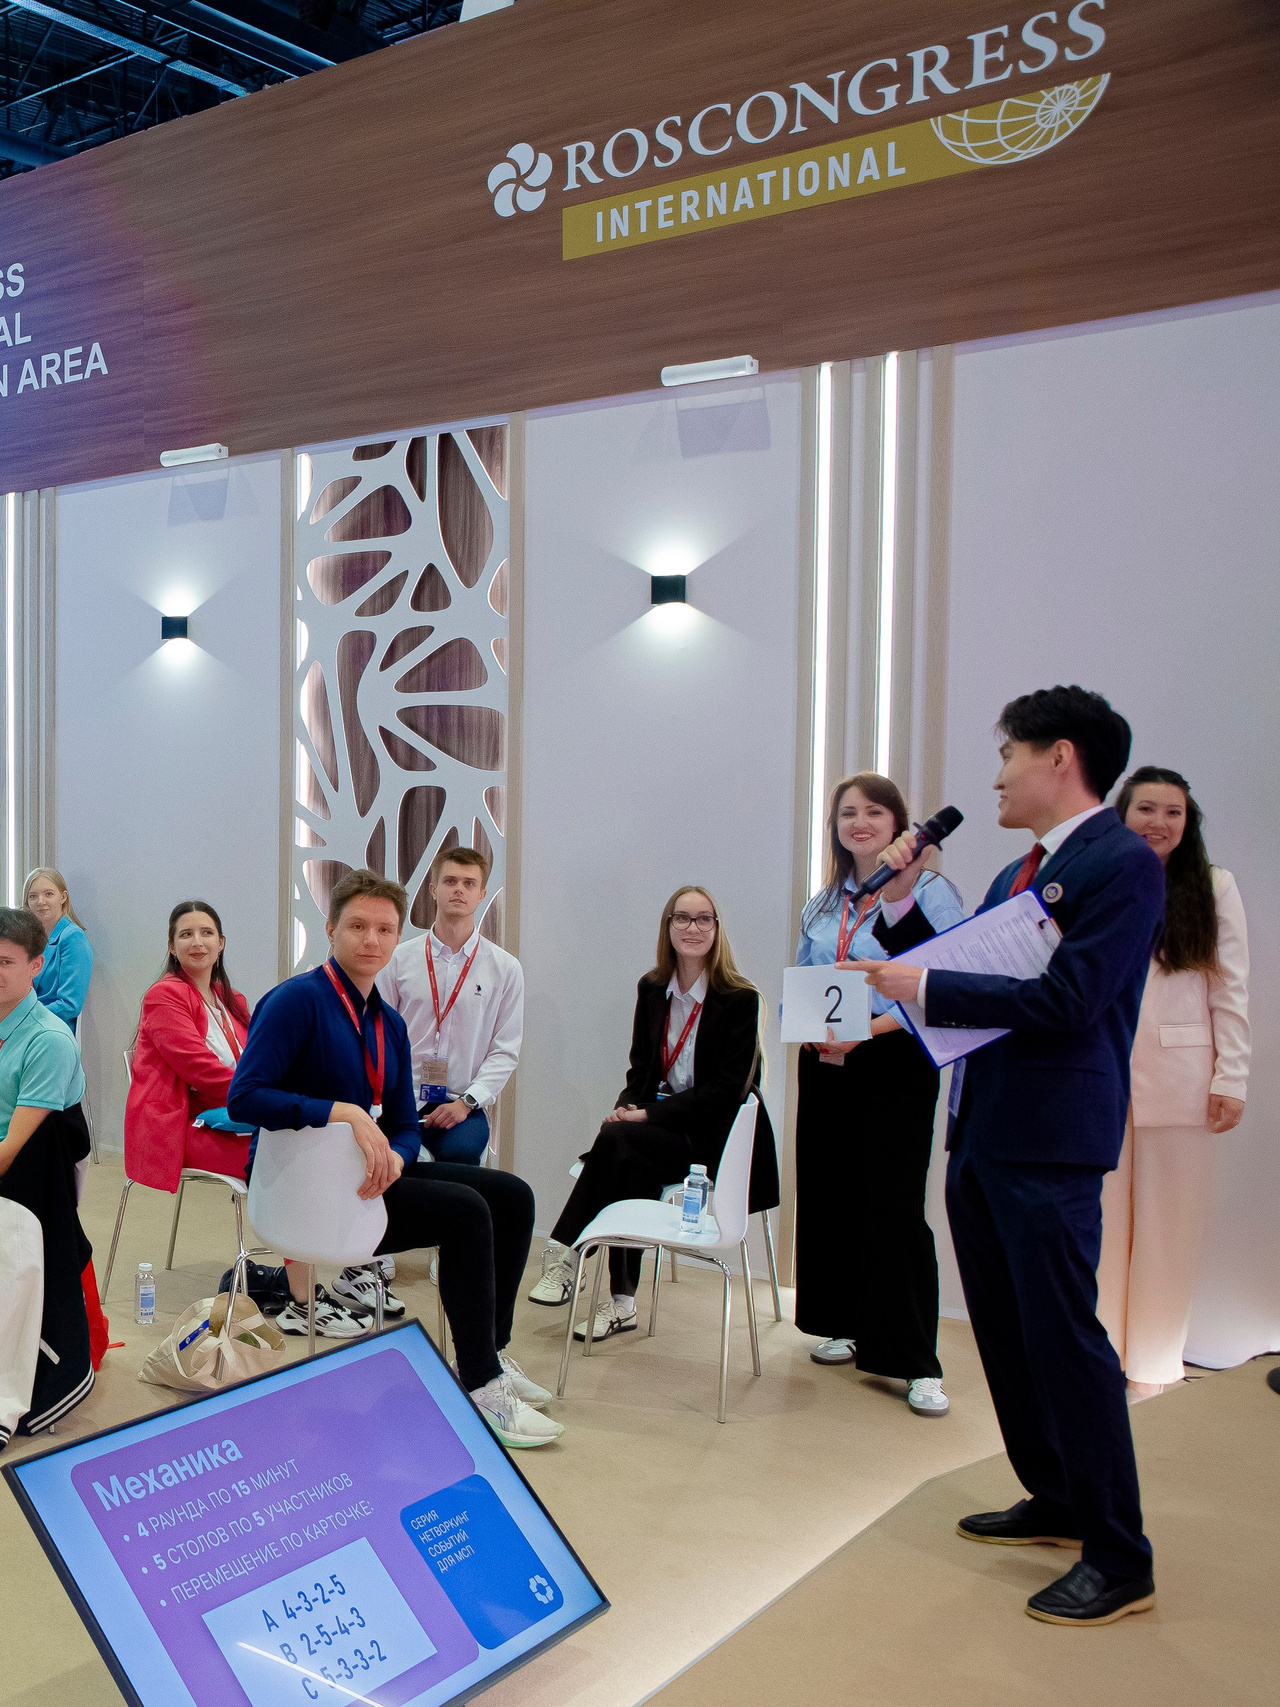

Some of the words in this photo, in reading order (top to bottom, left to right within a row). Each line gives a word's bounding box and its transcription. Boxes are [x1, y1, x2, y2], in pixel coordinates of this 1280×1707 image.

[562, 0, 1106, 192] ROSCONGRESS
[595, 140, 907, 244] INTERNATIONAL
[17, 342, 109, 394] AREA
[824, 985, 843, 1024] 2
[92, 1439, 243, 1511] Механика
[137, 1521, 149, 1538] 4
[148, 1498, 210, 1533] РАУНДА
[207, 1488, 232, 1510] ПО
[231, 1479, 251, 1499] 15
[249, 1458, 300, 1491] МИНУТ
[152, 1554, 167, 1571] 5
[167, 1527, 230, 1564] СТОЛОВ
[229, 1517, 253, 1539] ПО
[252, 1510, 265, 1527] 5
[263, 1472, 354, 1521] УЧАСТНИКОВ
[410, 1509, 440, 1530] СЕРИЯ
[418, 1510, 470, 1544] НЕТВОРКИНГ
[428, 1528, 470, 1558] СОБЫТИЙ
[170, 1542, 283, 1605] ПЕРЕМЕЩЕНИЕ
[280, 1532, 304, 1554] ПО
[301, 1500, 375, 1541] КАРТОЧКЕ:
[437, 1556, 457, 1574] ДЛЯ
[456, 1544, 476, 1562] МСП
[282, 1574, 346, 1619] 4-3-2-5
[299, 1607, 366, 1656] 2-5-4-3
[320, 1639, 387, 1689] 5-3-3-2
